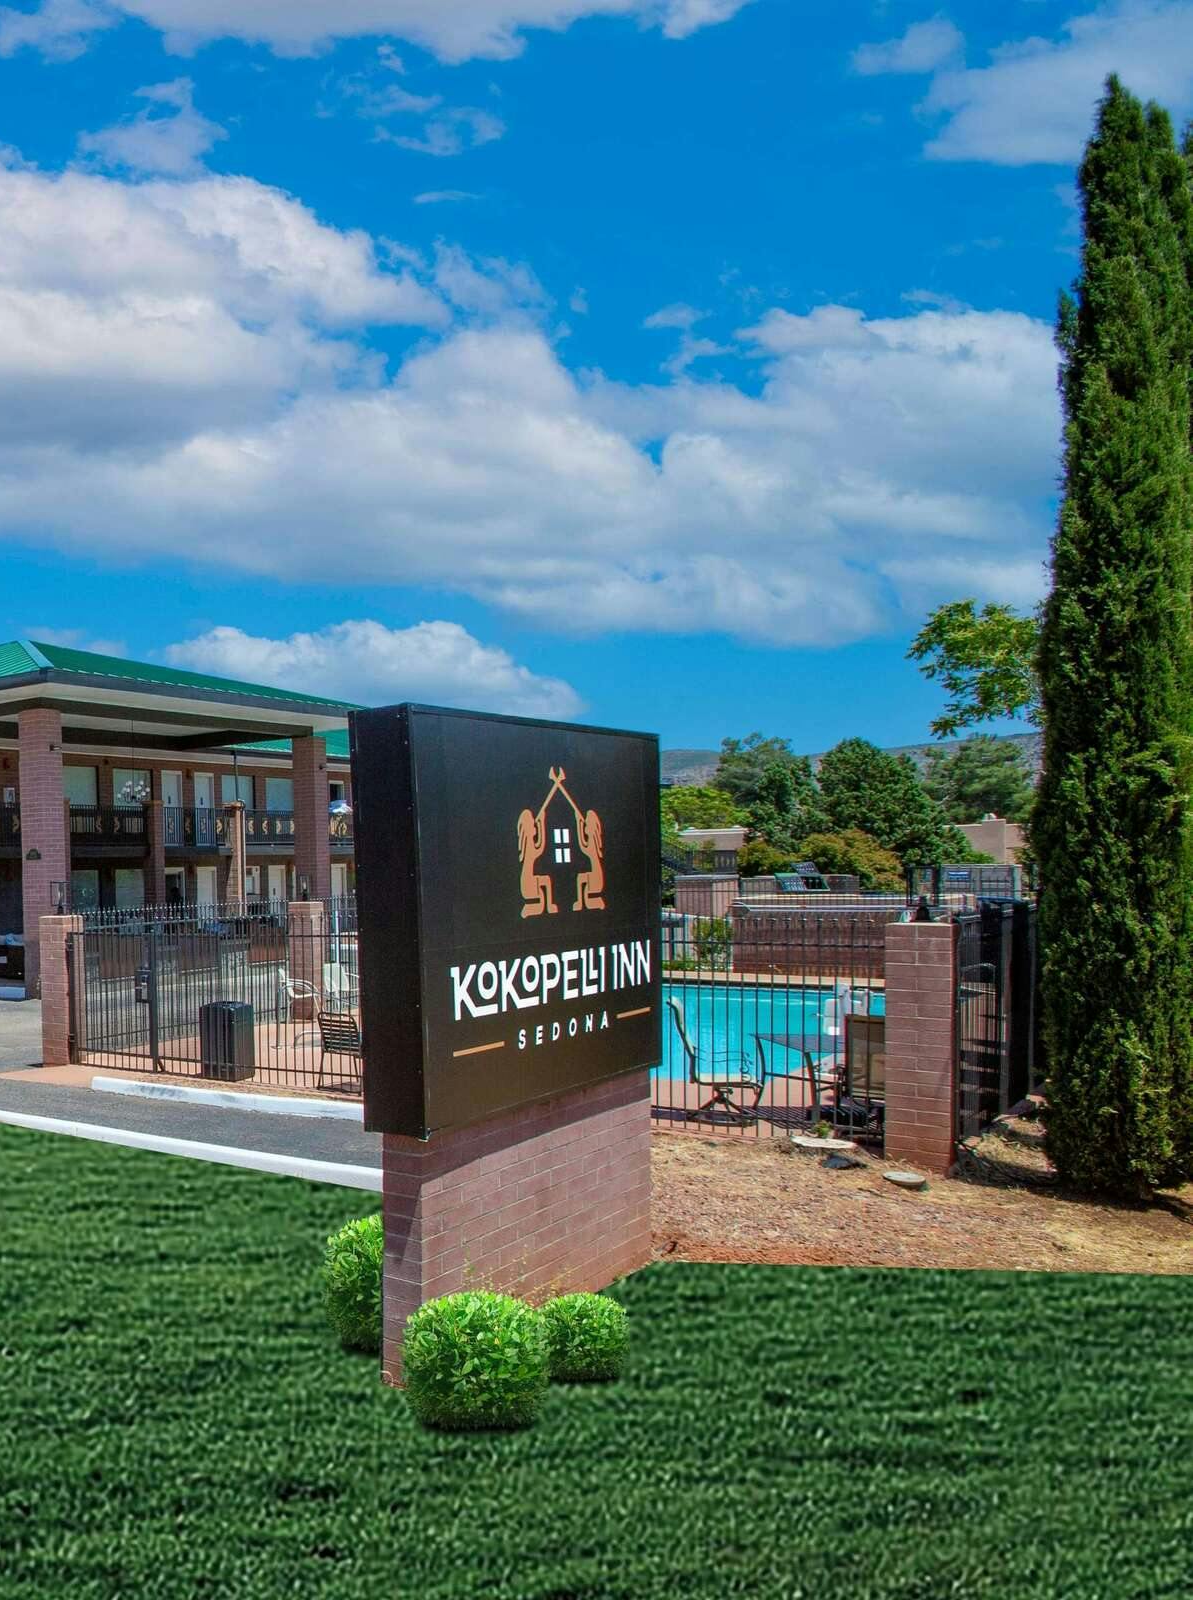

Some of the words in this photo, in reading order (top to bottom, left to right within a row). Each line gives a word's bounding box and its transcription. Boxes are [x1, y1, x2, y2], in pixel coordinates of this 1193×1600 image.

[450, 946, 606, 1021] KOKOPELLI
[611, 939, 651, 990] INN
[518, 1010, 609, 1050] SEDONA
